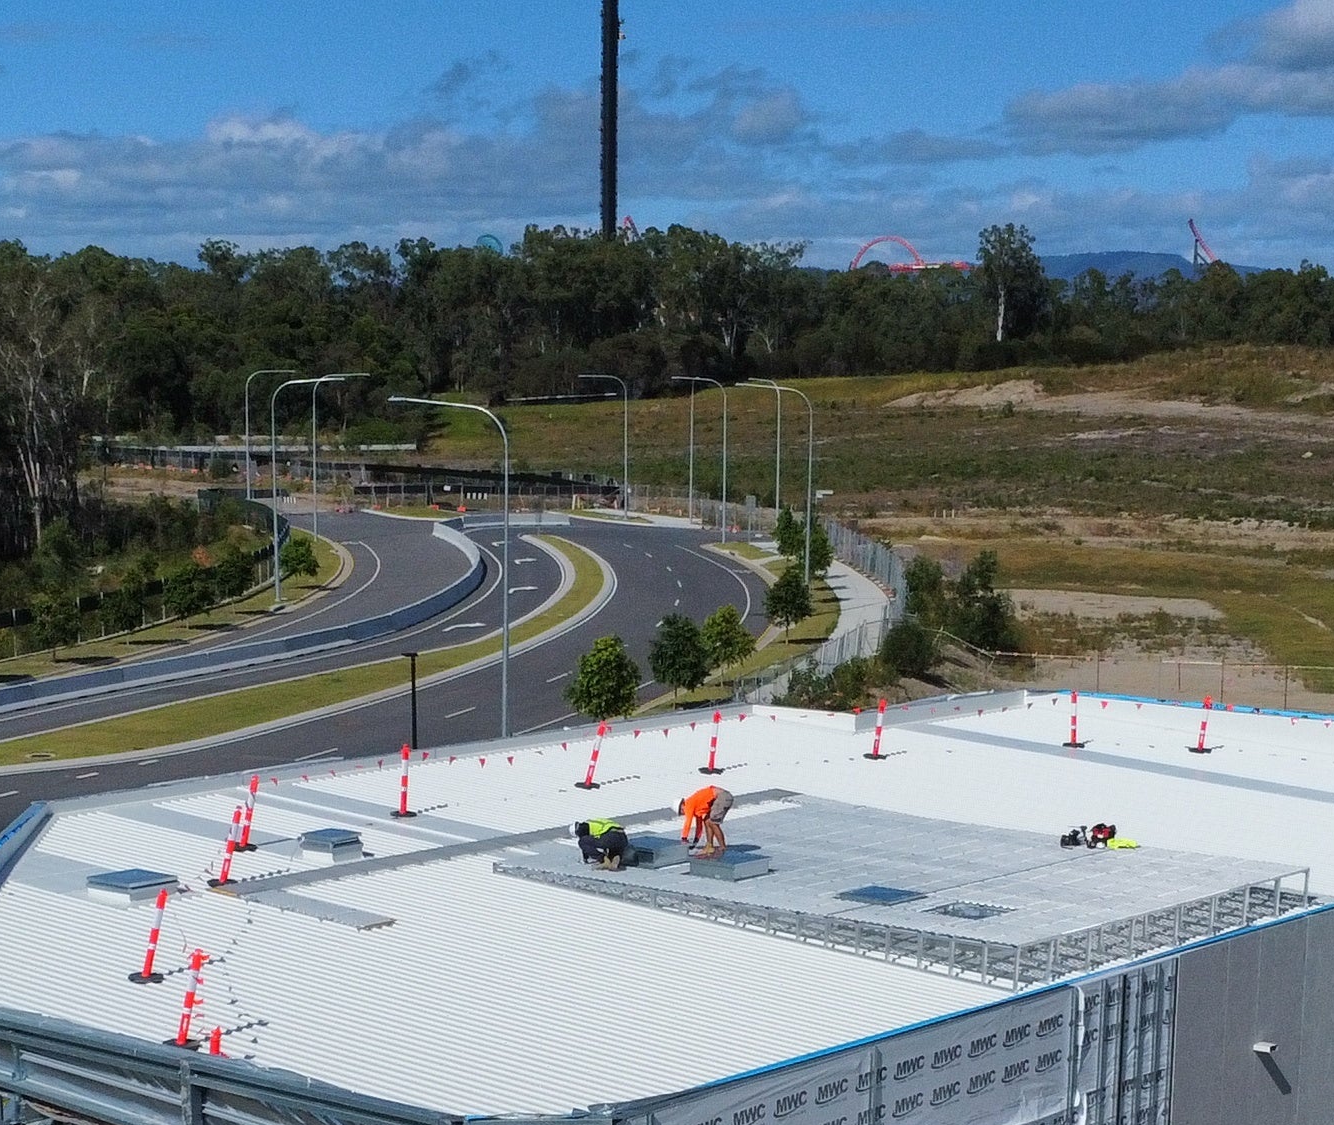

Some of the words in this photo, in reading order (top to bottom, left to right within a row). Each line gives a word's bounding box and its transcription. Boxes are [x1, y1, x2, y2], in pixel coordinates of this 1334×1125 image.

[776, 1090, 808, 1116] MWC
[817, 1078, 849, 1103] MWC
[896, 1055, 925, 1077] MWC
[933, 1044, 962, 1066] MWC
[970, 1033, 997, 1055] MWC
[1006, 1023, 1031, 1044] MWC
[1038, 1014, 1064, 1035] MWC
[895, 1092, 924, 1115] MWC
[932, 1081, 961, 1103] MWC
[969, 1070, 996, 1092] MWC
[1004, 1059, 1030, 1080] MWC
[1037, 1049, 1062, 1070] MWC
